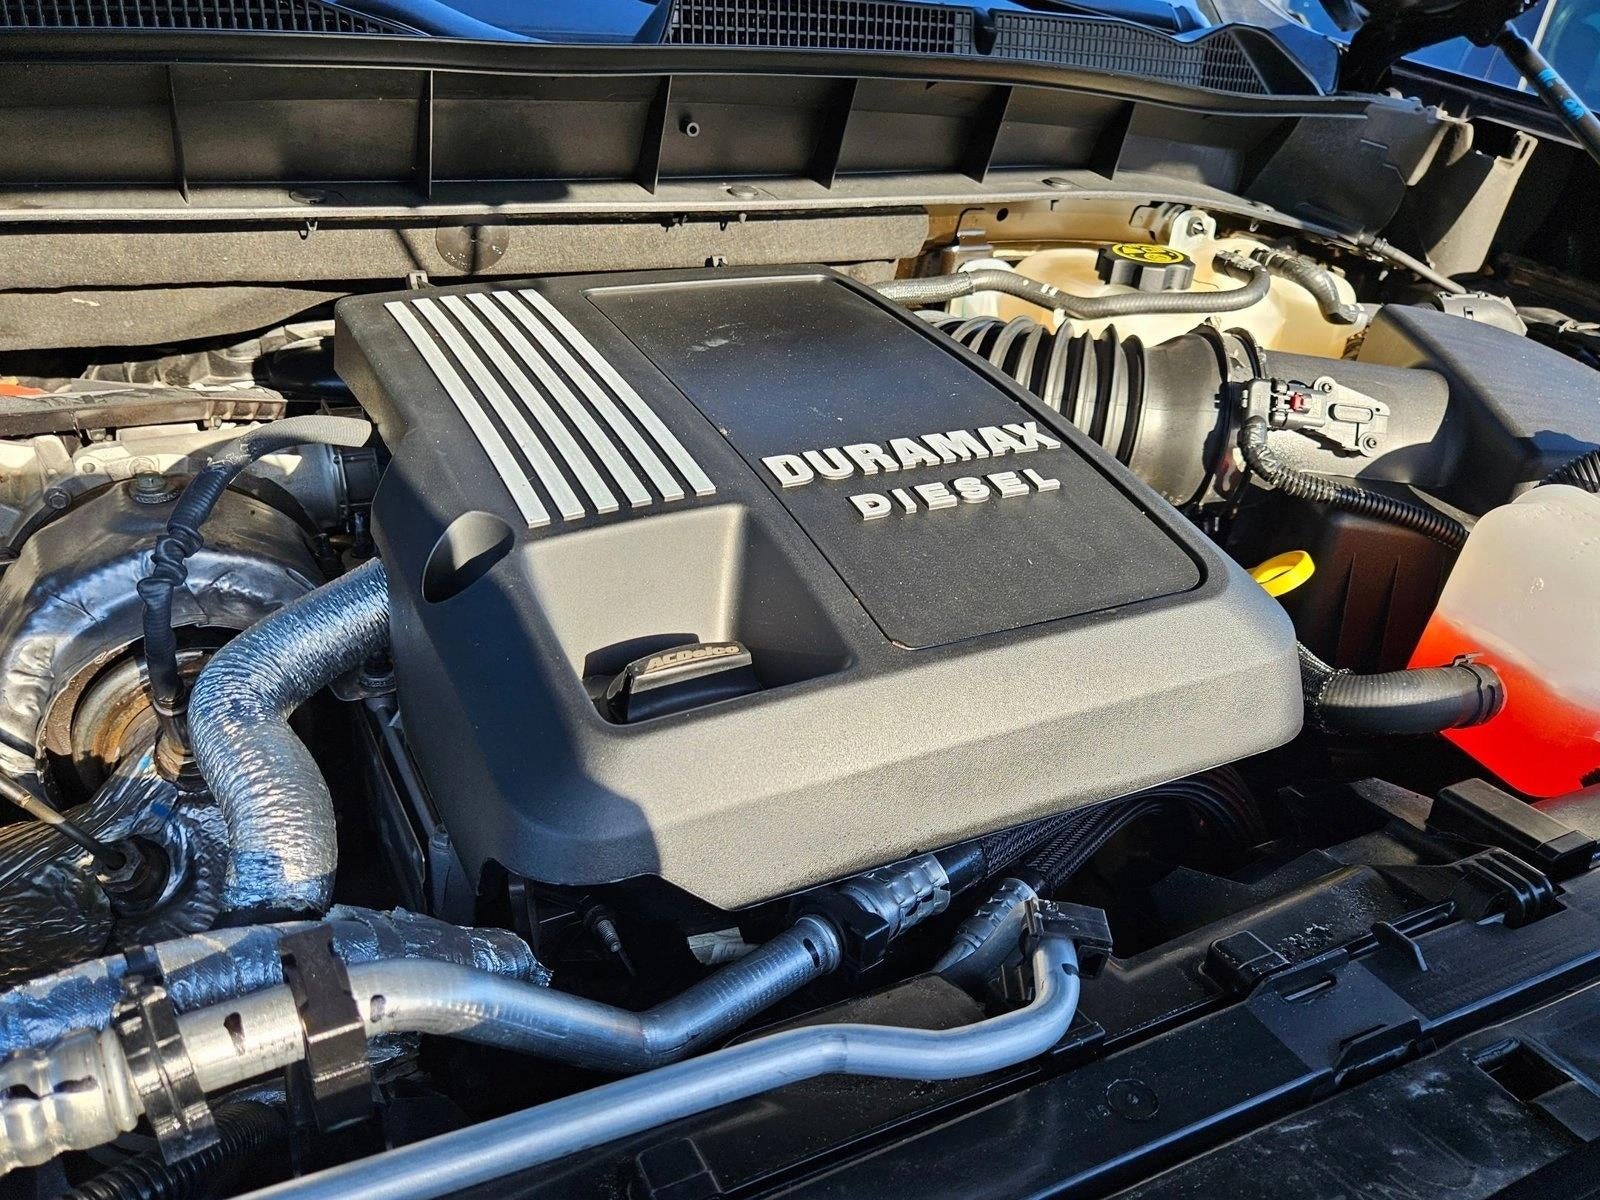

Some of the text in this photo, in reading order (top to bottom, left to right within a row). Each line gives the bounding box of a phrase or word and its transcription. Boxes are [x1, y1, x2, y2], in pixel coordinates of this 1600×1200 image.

[762, 421, 1061, 488] DURAMAX
[850, 468, 1060, 520] DIESEL
[647, 645, 740, 671] ACDelco
